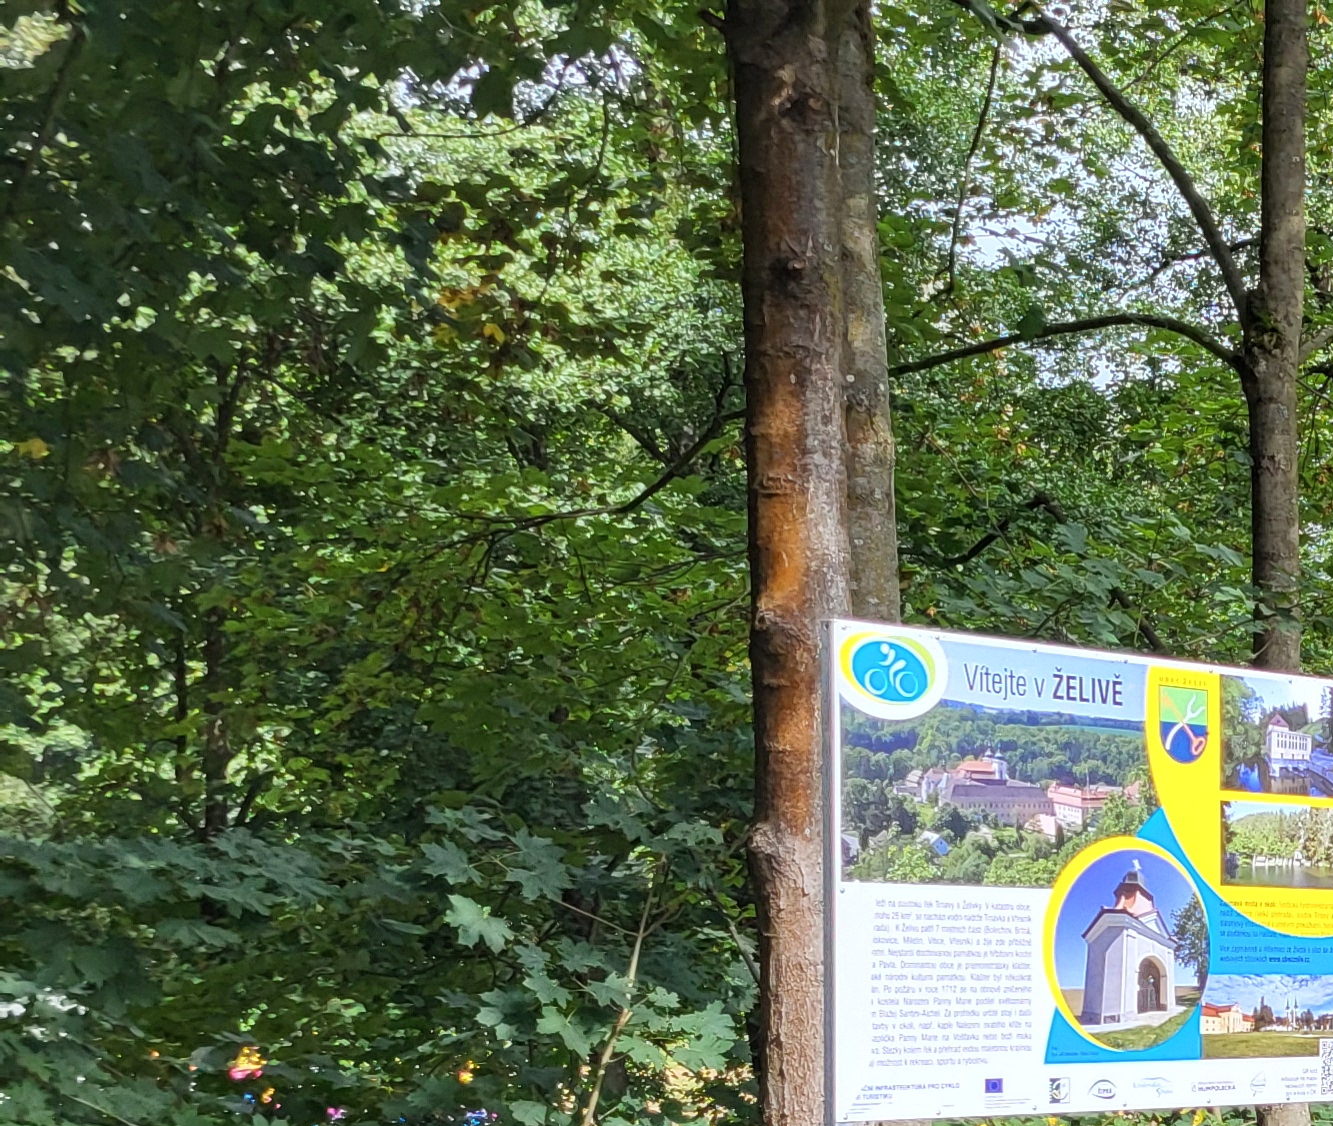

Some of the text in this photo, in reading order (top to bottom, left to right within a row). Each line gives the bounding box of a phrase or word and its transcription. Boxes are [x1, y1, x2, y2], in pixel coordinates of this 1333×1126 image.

[964, 663, 1123, 706] Vítejte v ŽELIVĚ
